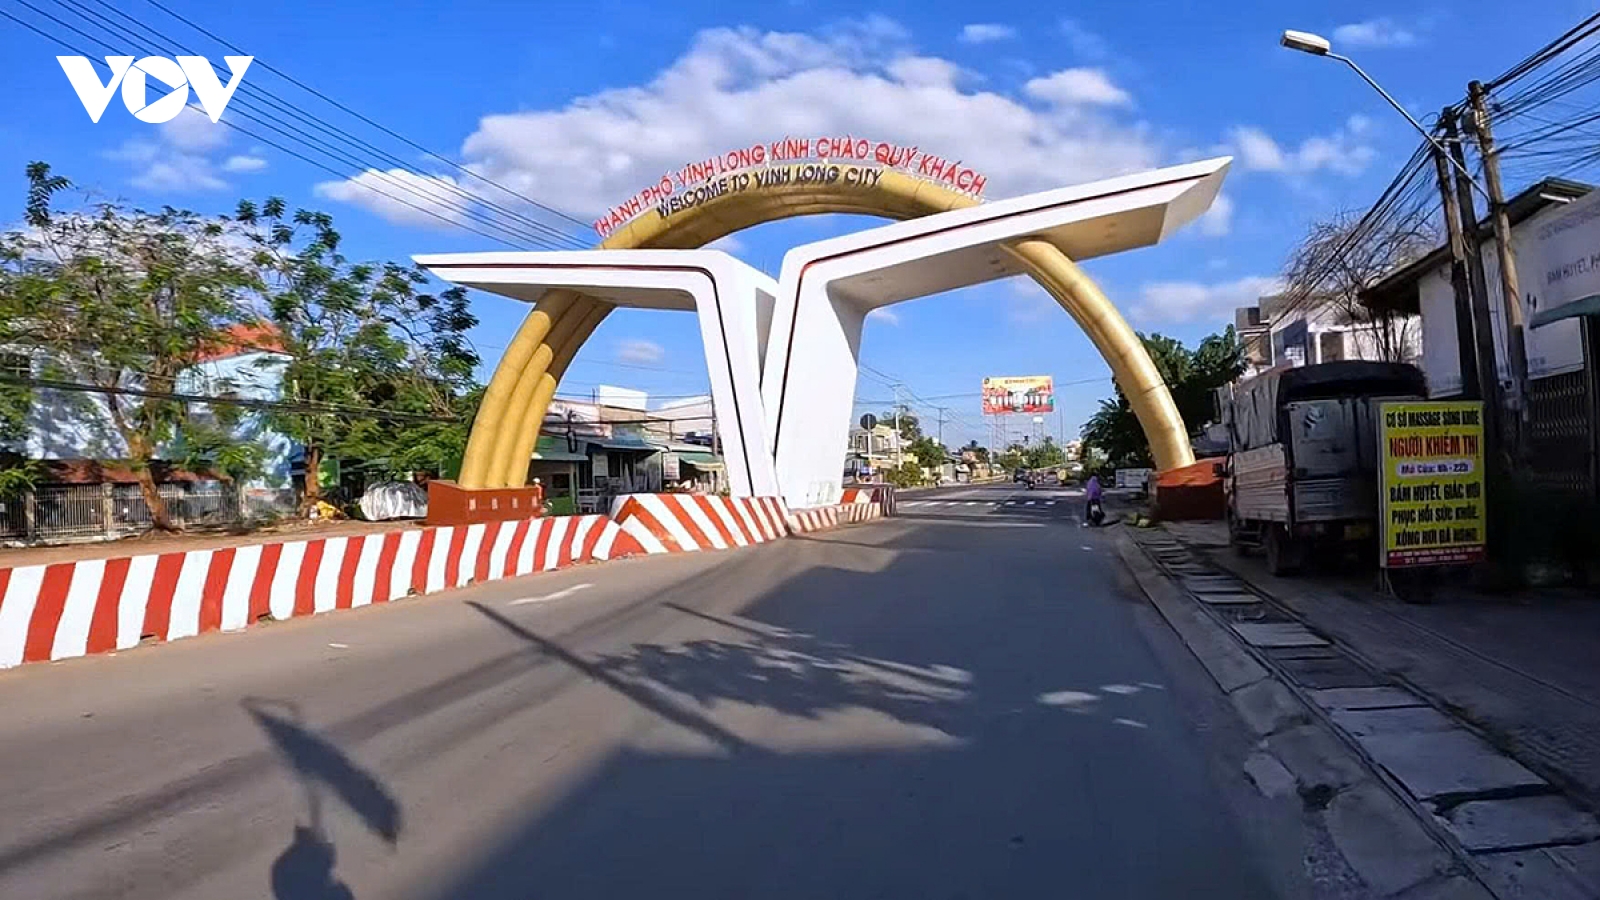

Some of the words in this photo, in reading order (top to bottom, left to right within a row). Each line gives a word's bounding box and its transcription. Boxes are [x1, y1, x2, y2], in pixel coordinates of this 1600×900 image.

[593, 195, 642, 237] THÀNH
[717, 145, 766, 173] LONG
[771, 135, 809, 160] KÍNH
[816, 135, 870, 159] CHÀO
[875, 143, 918, 167] QUÝ
[919, 154, 987, 194] KHÁCH
[657, 177, 729, 219] WELCOME
[730, 173, 750, 191] TO
[755, 167, 791, 187] VINH
[795, 164, 840, 185] LONG
[845, 167, 884, 187] CITY
[1408, 411, 1440, 427] MASSAGE
[1390, 432, 1423, 457] NGƯỜI
[1426, 430, 1460, 456] KHIẾM
[1463, 435, 1479, 459] THỊ
[1444, 480, 1464, 499] GIÁC
[1391, 508, 1416, 526] PHỤC
